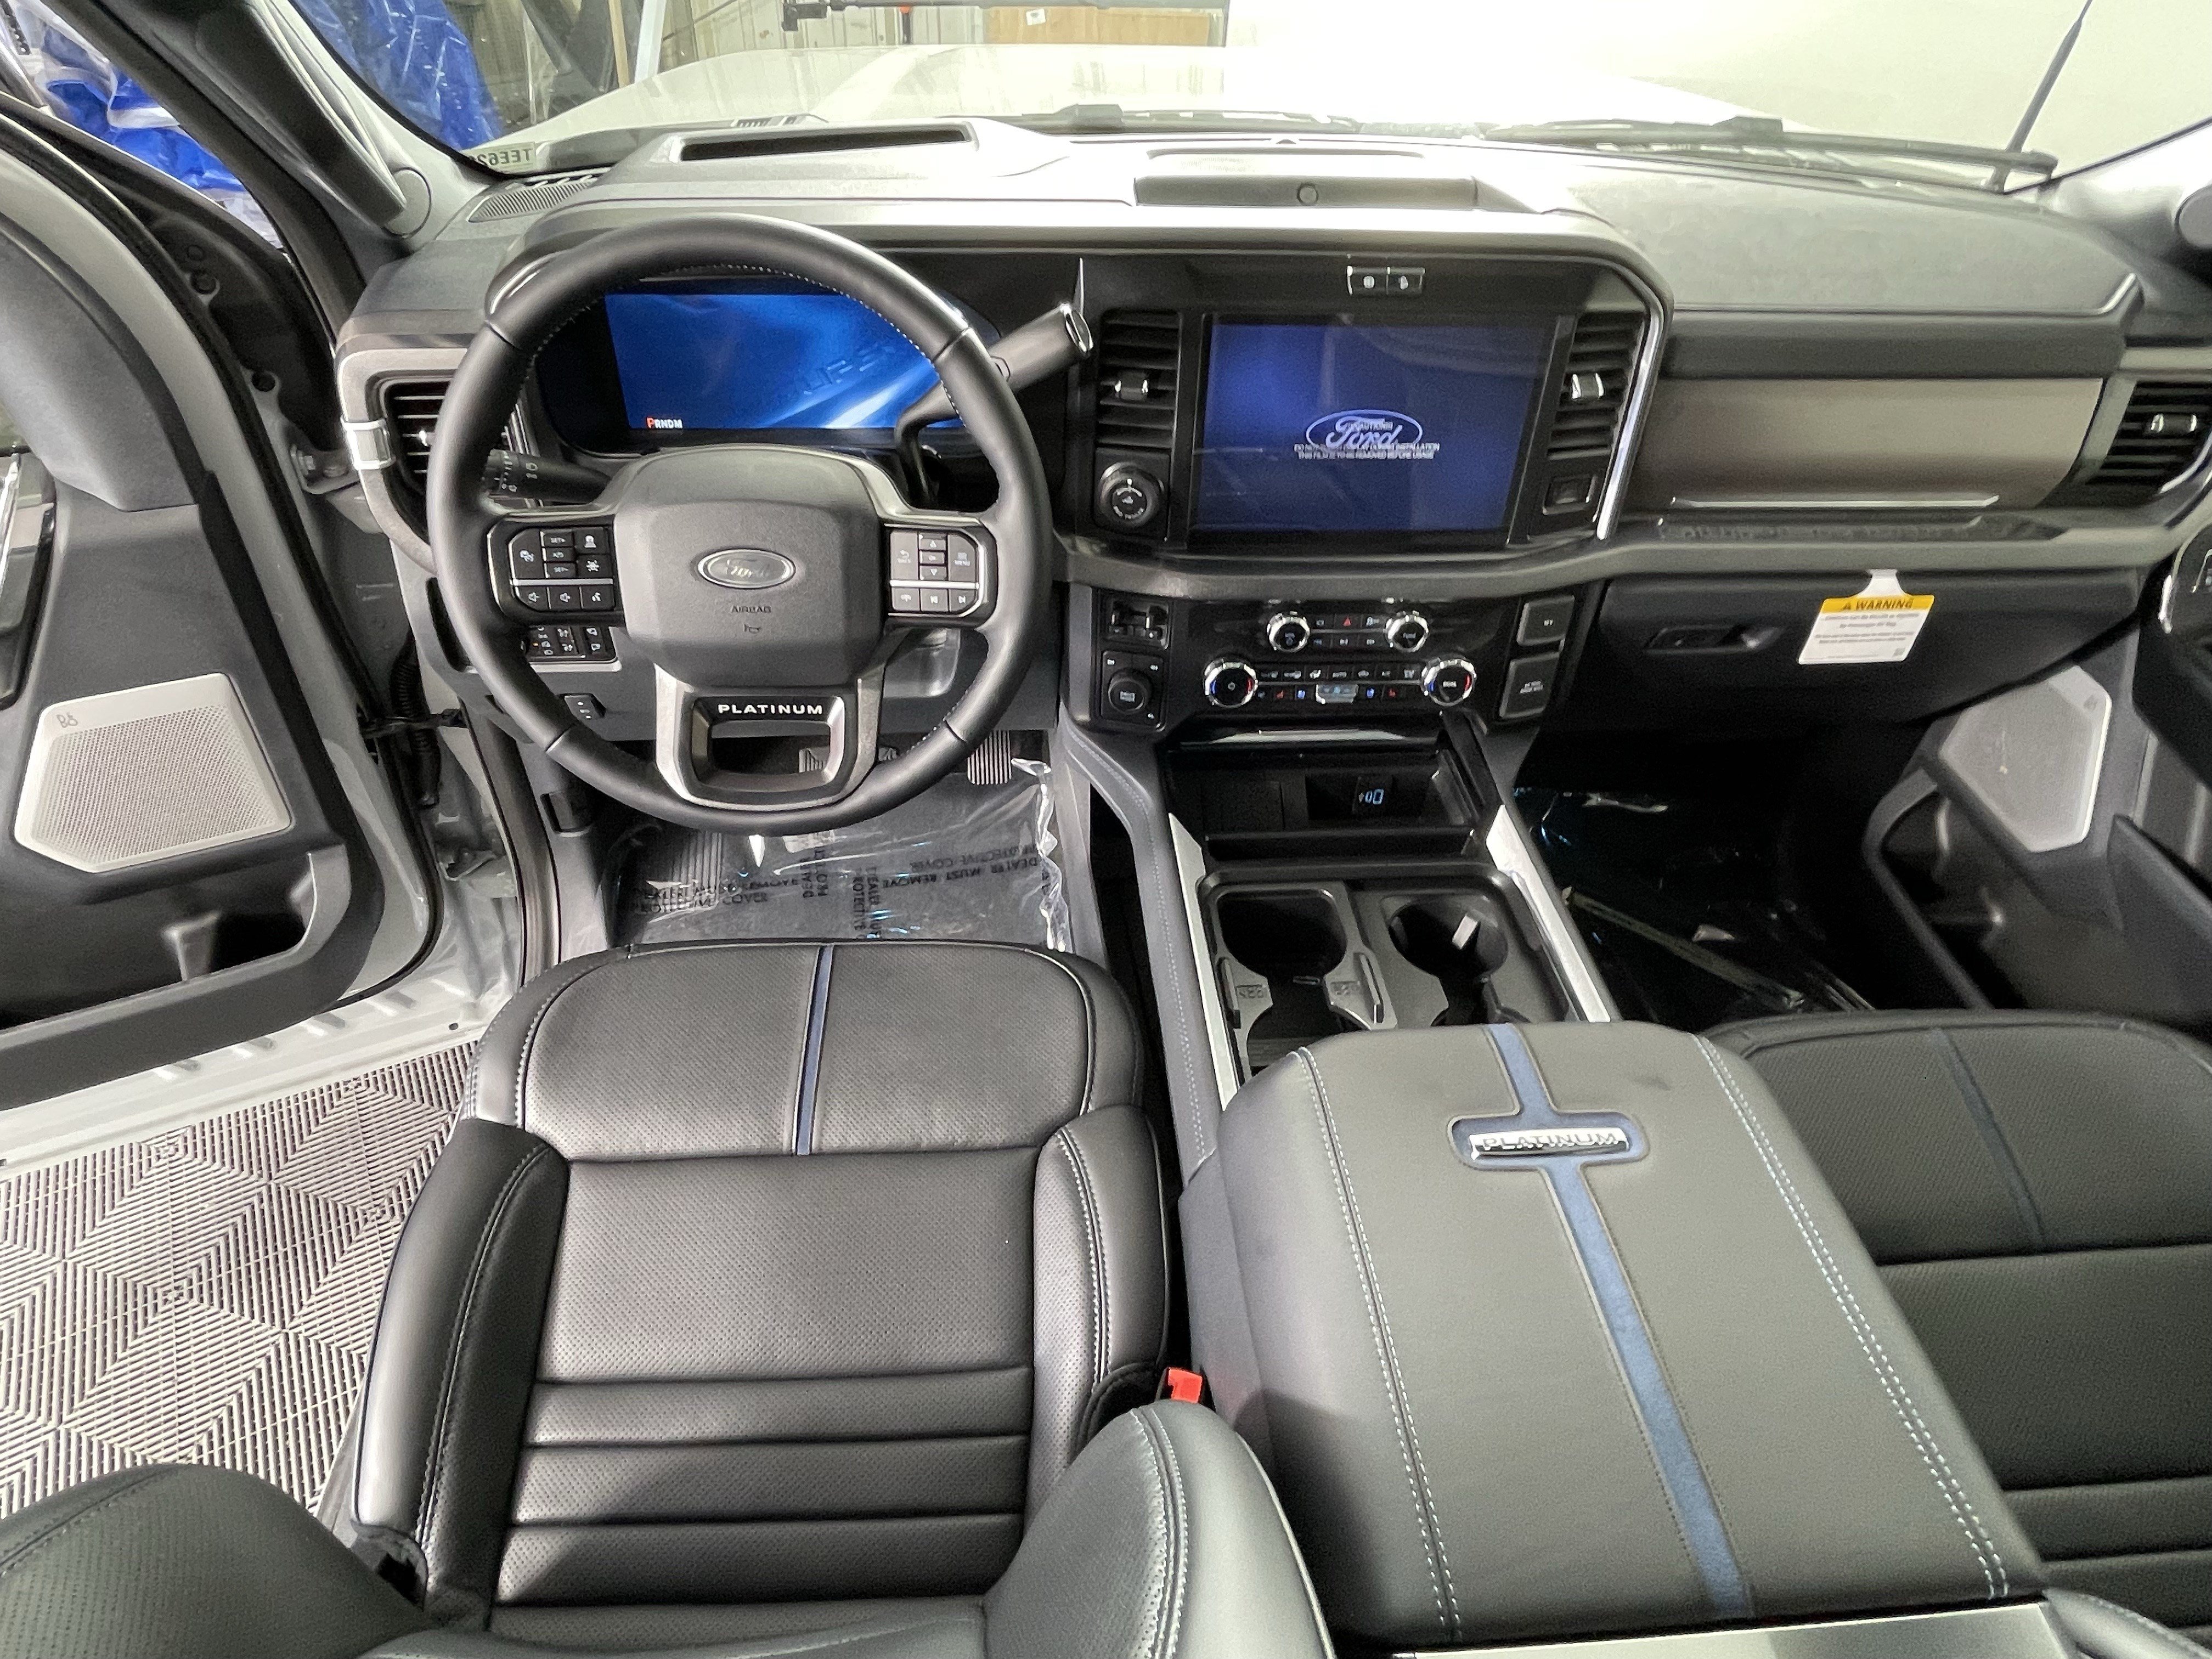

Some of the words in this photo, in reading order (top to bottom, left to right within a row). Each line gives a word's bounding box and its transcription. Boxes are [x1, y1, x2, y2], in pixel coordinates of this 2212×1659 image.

[1325, 415, 1402, 450] Ford
[731, 605, 771, 614] AIRBAG
[1855, 599, 1914, 611] WARNING
[718, 704, 822, 714] PLATINUM
[946, 867, 982, 881] MUST
[722, 892, 768, 905] COVER
[1482, 1132, 1617, 1151] PLATINUM
